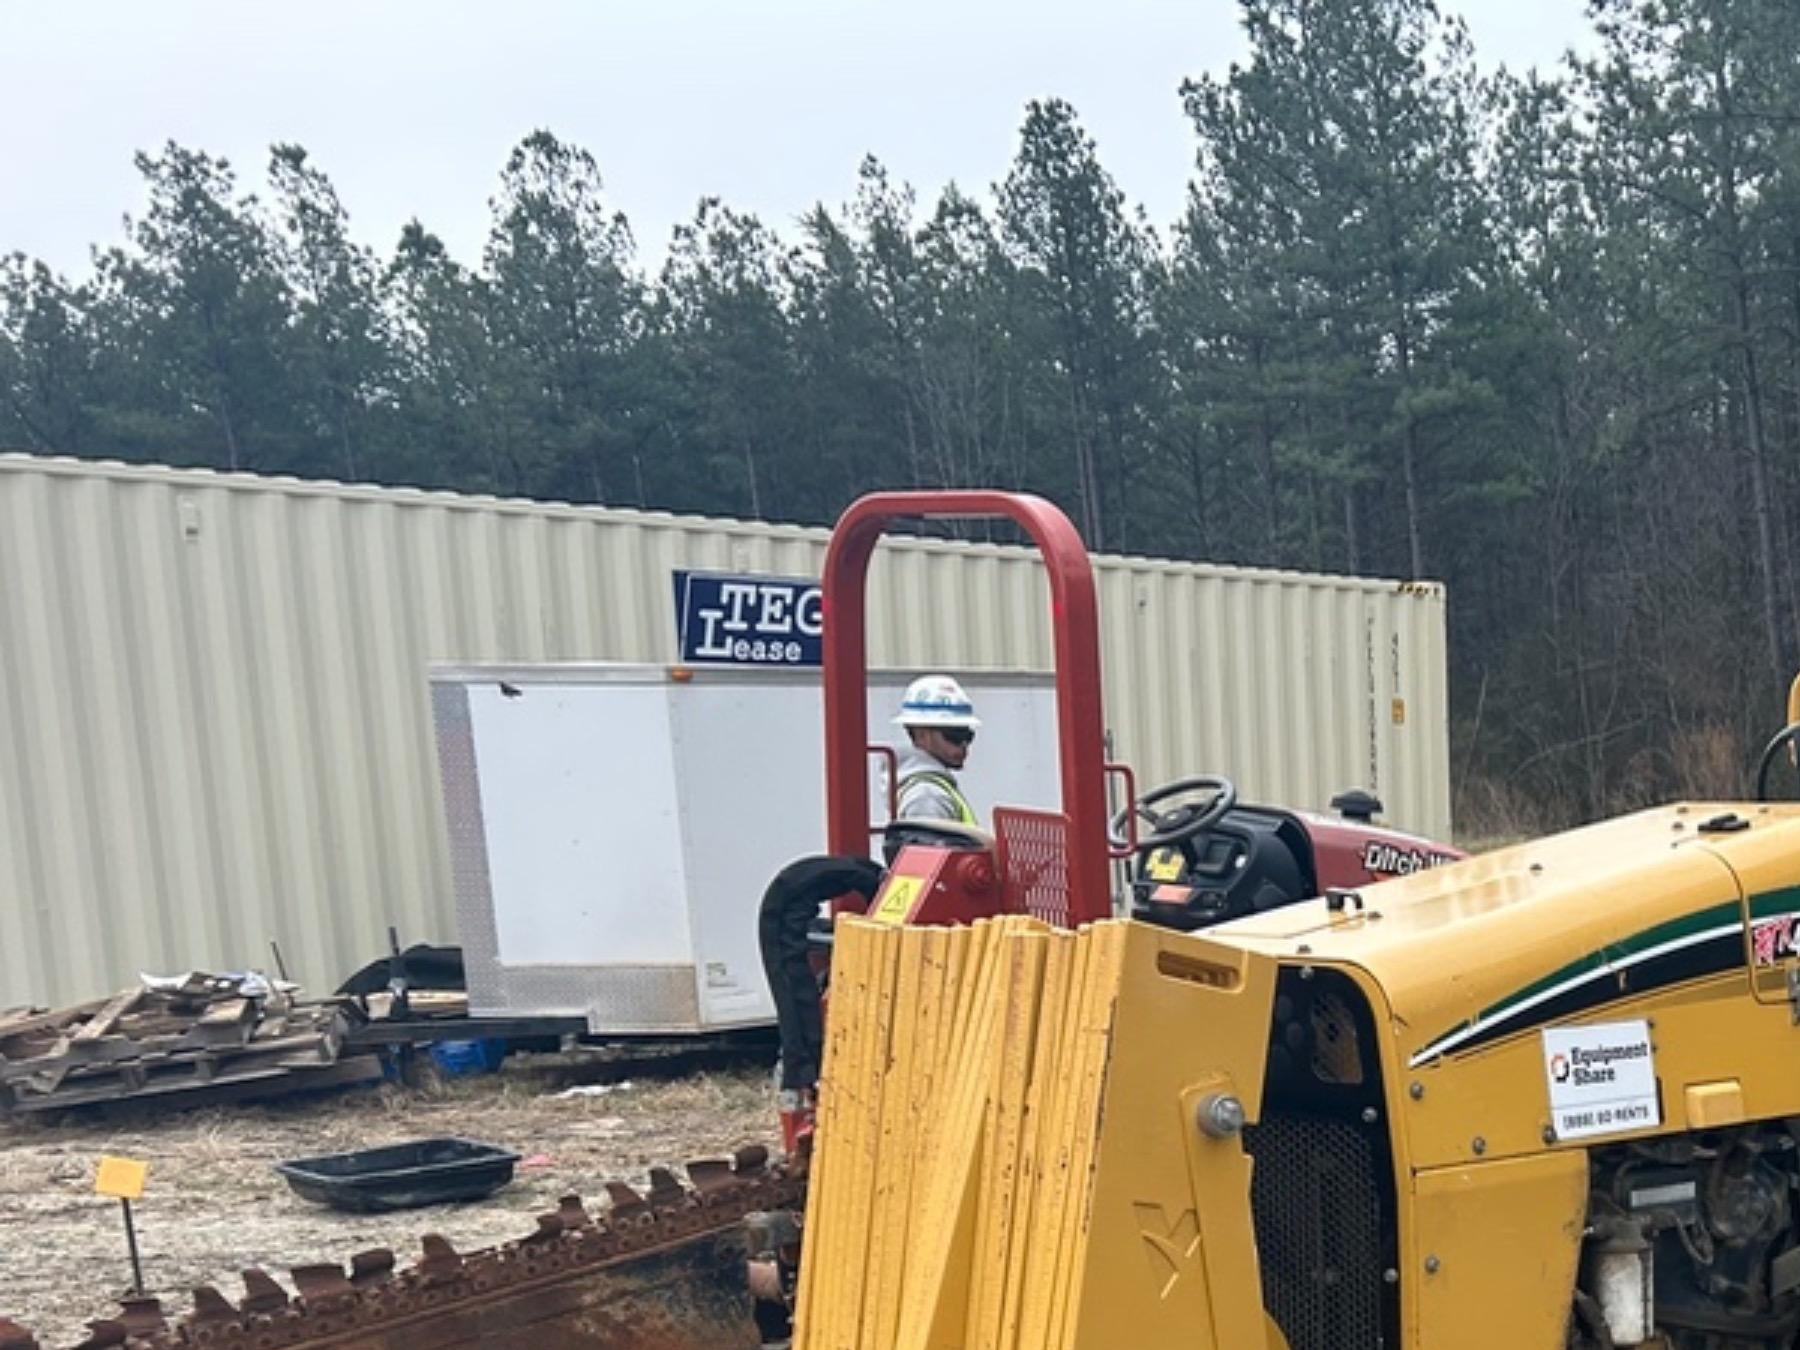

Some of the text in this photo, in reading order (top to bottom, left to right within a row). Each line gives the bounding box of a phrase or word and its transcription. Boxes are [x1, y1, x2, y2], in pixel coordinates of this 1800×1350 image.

[695, 608, 802, 661] Lease
[1570, 1041, 1648, 1067] Equipment
[1573, 1067, 1615, 1086] Share
